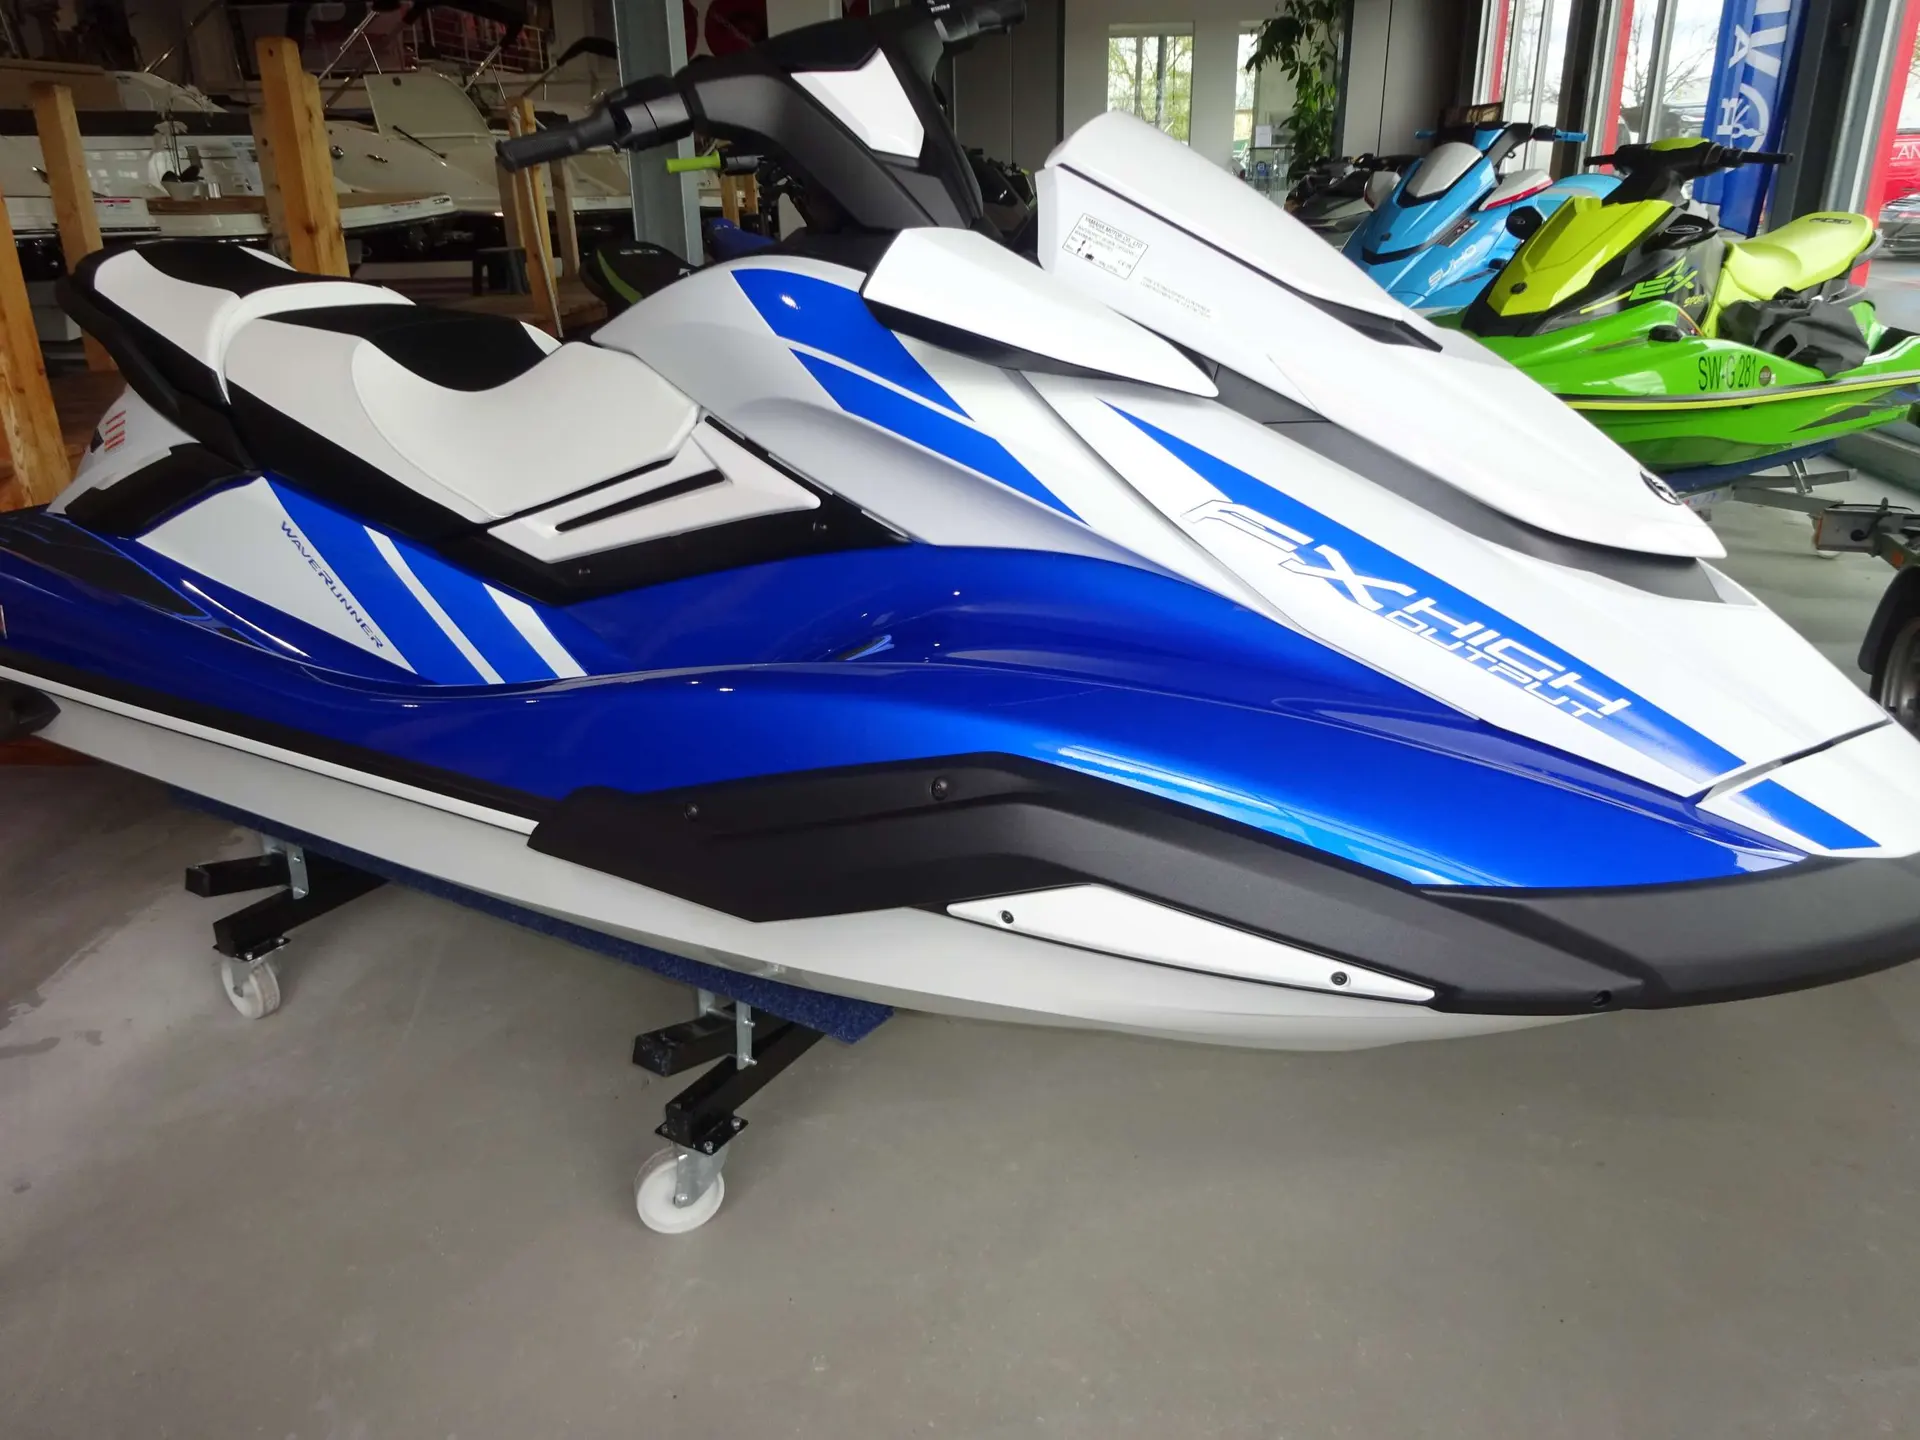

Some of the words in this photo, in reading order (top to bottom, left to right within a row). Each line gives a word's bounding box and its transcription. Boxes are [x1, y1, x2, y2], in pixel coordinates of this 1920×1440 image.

[1629, 258, 1698, 301] EX
[1738, 354, 1757, 388] 281
[281, 521, 384, 649] WAVERUNNER
[1180, 500, 1416, 611] FX
[1403, 598, 1632, 714] HIGH
[1386, 610, 1604, 719] OUTPUT
